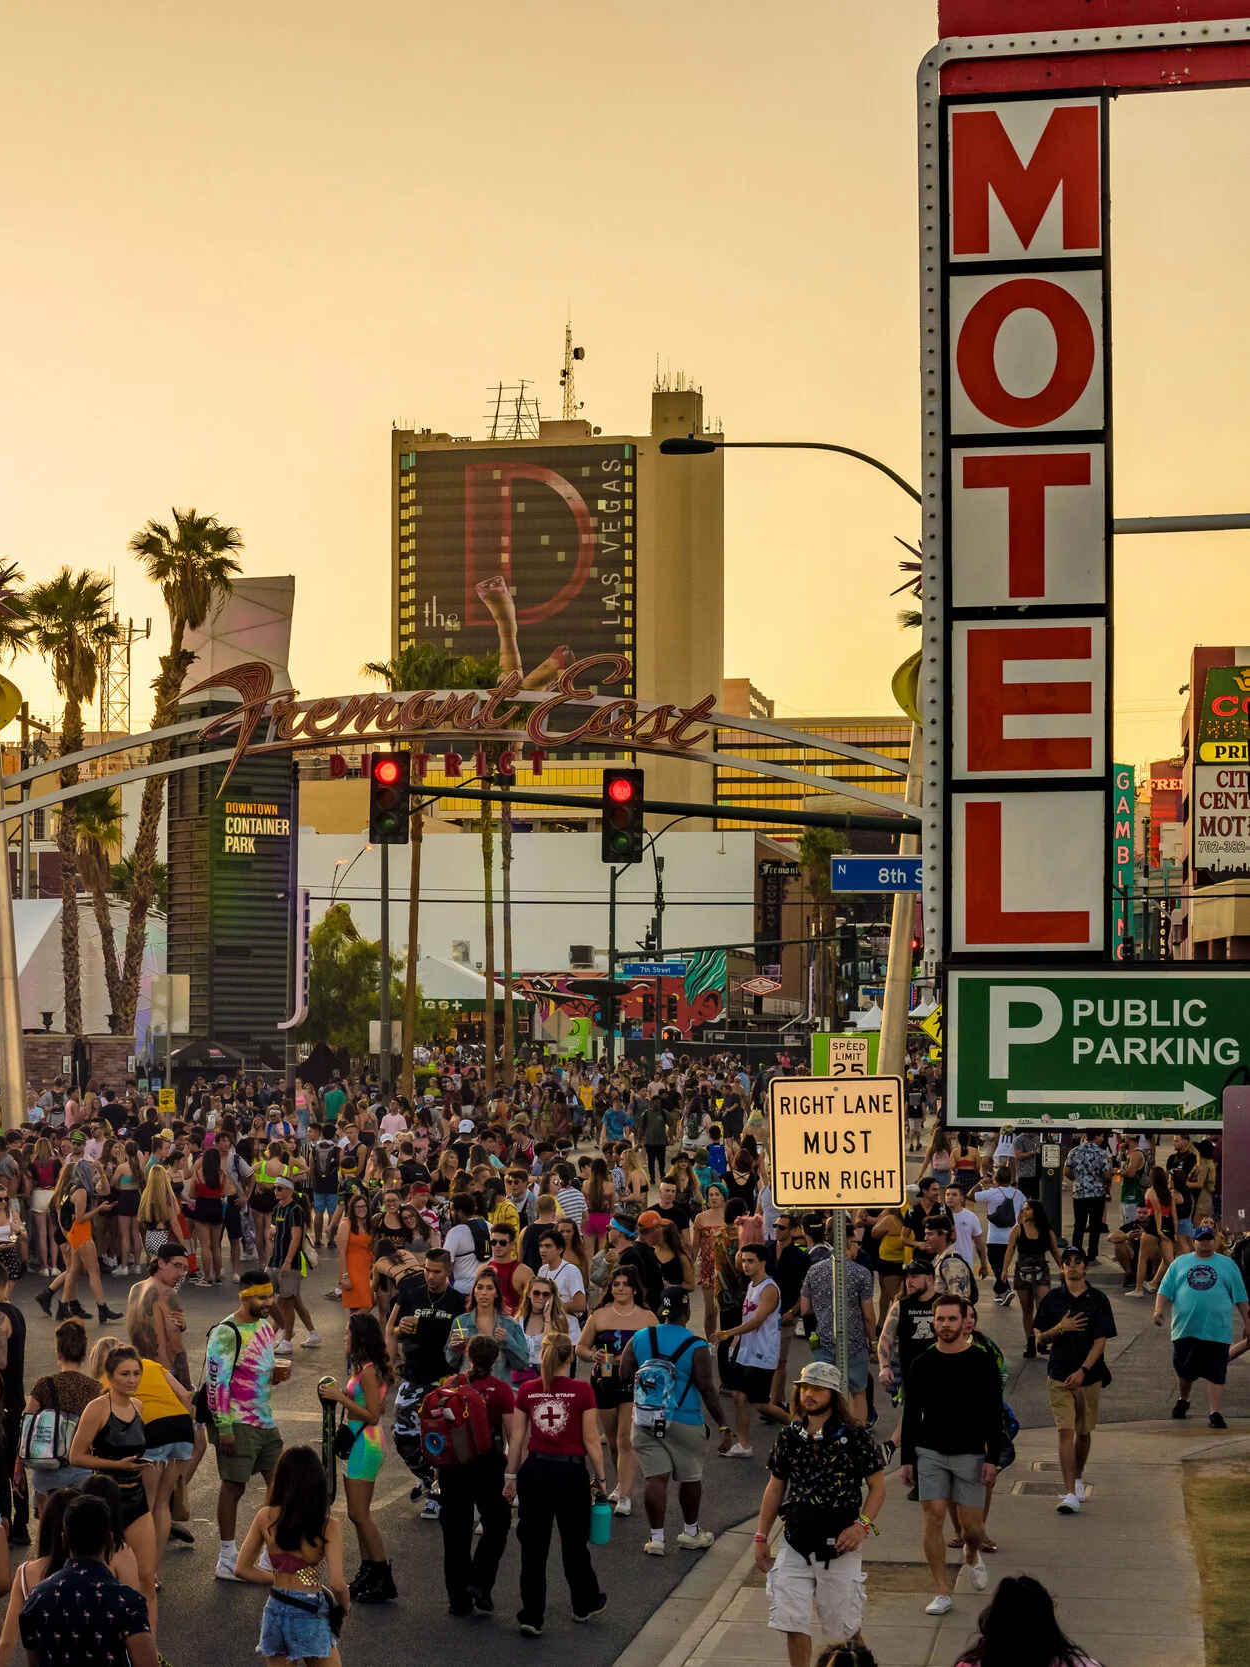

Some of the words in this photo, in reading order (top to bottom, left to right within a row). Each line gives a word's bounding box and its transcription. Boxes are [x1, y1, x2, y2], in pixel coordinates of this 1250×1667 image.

[601, 458, 621, 554] VEGAS
[952, 105, 1100, 944] MOTEL
[423, 595, 460, 628] the
[465, 462, 595, 627] D
[601, 572, 621, 625] LAS
[1211, 695, 1248, 717] C
[168, 661, 524, 799] Fremont
[526, 653, 718, 748] East
[330, 749, 548, 779] DITRICT
[225, 802, 279, 816] DOWNTOWN
[224, 816, 290, 836] CONTAINER
[1198, 815, 1250, 838] MOT
[224, 835, 256, 855] PARK
[838, 864, 847, 875] N
[878, 867, 907, 884] 8th
[1073, 998, 1208, 1027] PUBLIC
[989, 985, 1063, 1080] P
[832, 1042, 866, 1051] SPEED
[835, 1052, 862, 1061] LIMIT
[1072, 1037, 1240, 1066] PARKING
[832, 1063, 865, 1076] 25
[780, 1095, 836, 1116] RIGHT
[843, 1094, 894, 1115] LANE
[804, 1130, 872, 1155] MUST
[780, 1171, 831, 1191] TURN
[840, 1169, 896, 1190] RIGHT
